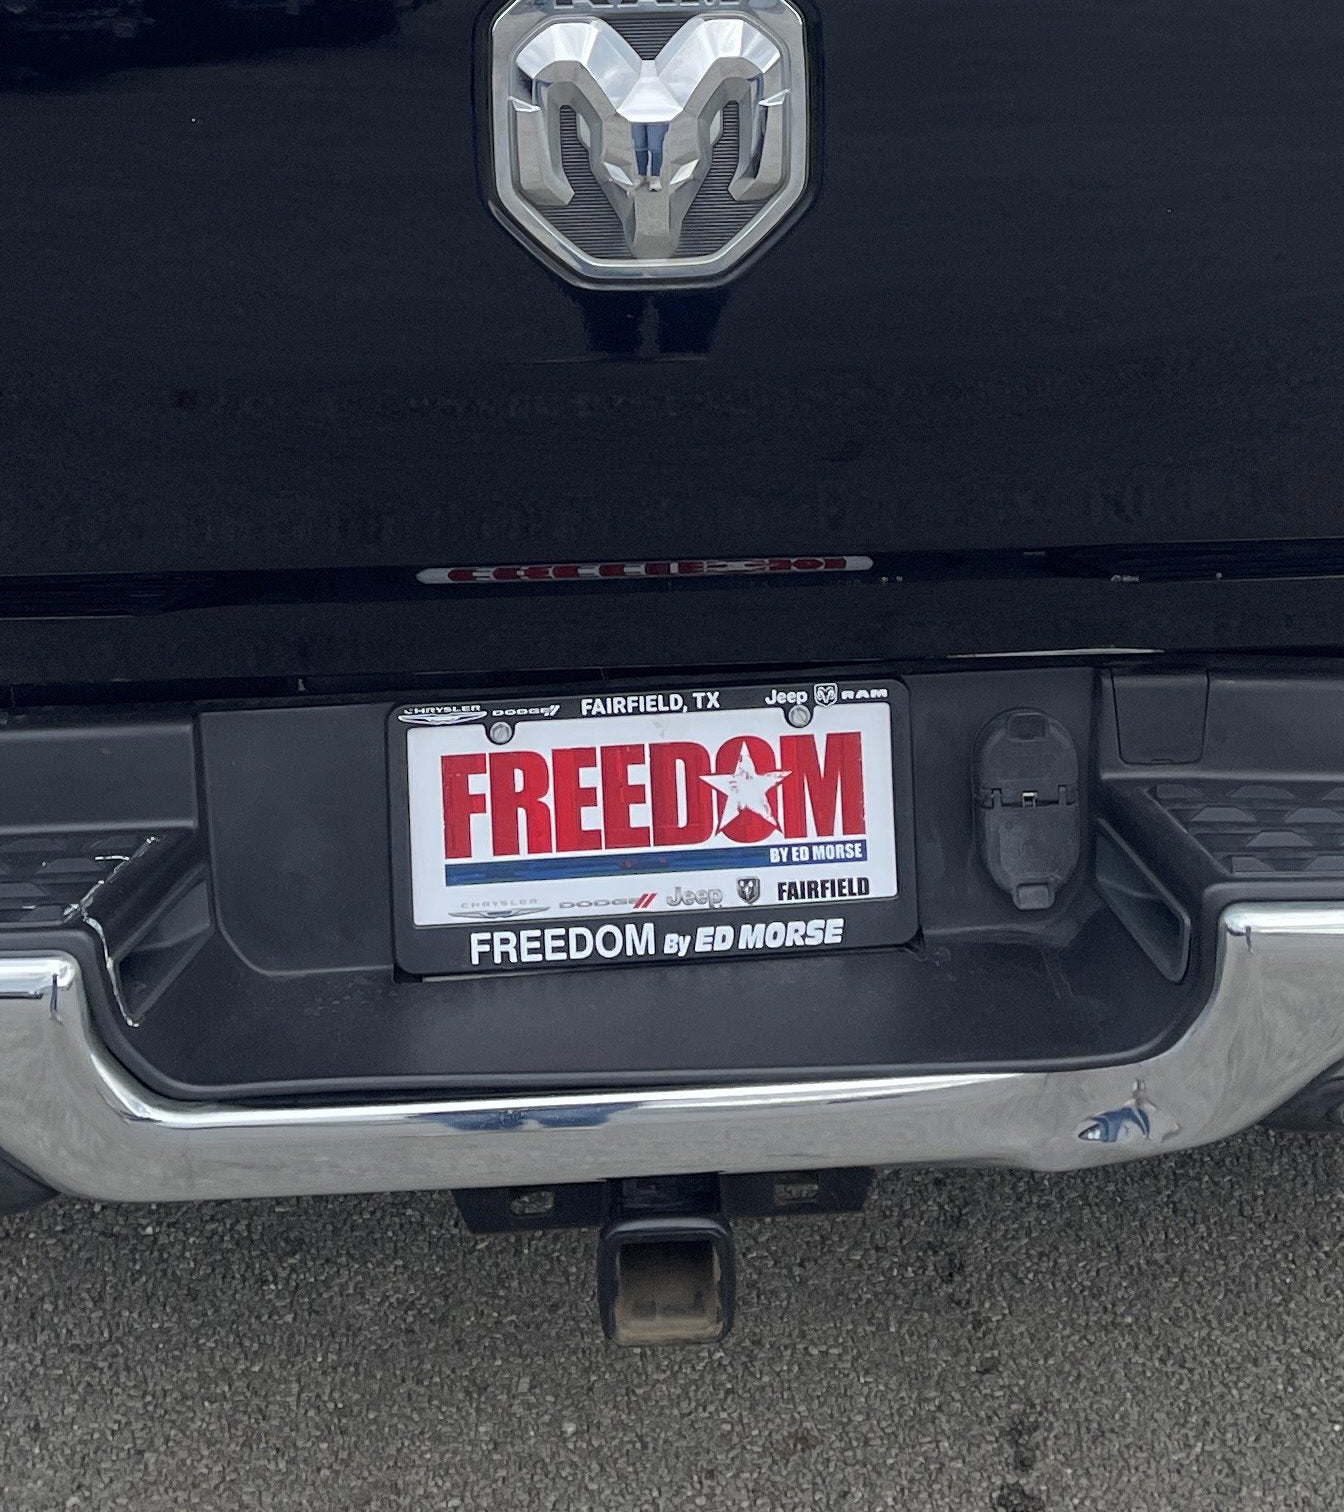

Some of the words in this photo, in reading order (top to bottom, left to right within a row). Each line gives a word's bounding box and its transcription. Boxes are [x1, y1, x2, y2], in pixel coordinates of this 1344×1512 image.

[581, 694, 688, 715] FAIRFIELD,
[692, 691, 721, 709] TX
[765, 689, 808, 706] Jeep
[841, 688, 888, 700] RAM
[441, 732, 867, 860] FREEDOM
[769, 847, 789, 863] BY
[791, 846, 809, 861] ED
[812, 843, 863, 860] MORSE
[460, 898, 538, 909] CHRYSLER
[666, 887, 723, 909] Jeep
[777, 877, 870, 900] FAIRFIELD
[470, 922, 655, 965] FREEDOM
[663, 933, 691, 957] By
[694, 925, 735, 952] ED
[738, 918, 844, 950] MORSE
